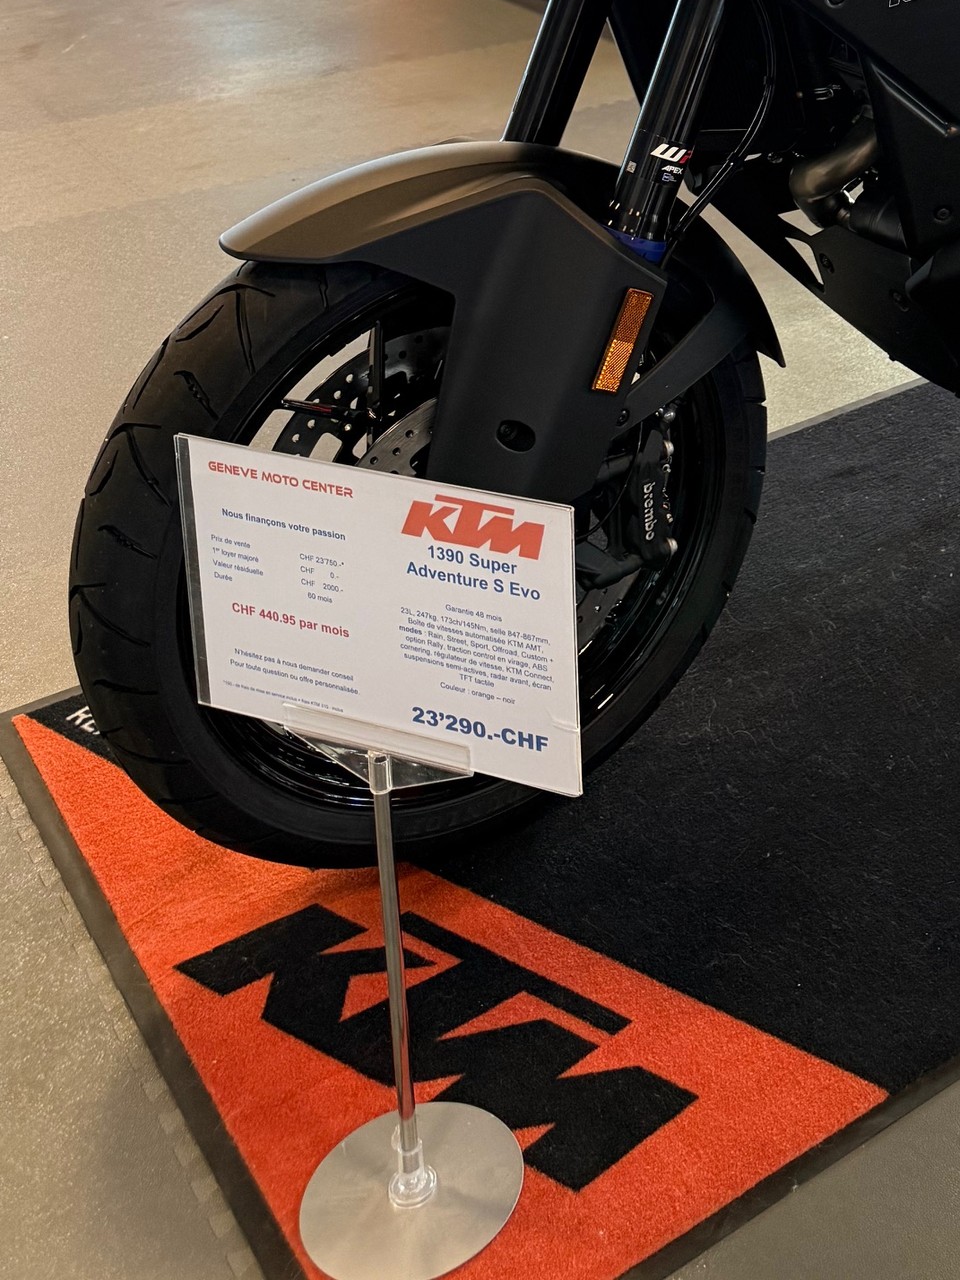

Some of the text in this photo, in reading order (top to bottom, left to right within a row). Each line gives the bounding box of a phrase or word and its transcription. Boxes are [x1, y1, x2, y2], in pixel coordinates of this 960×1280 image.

[661, 165, 684, 175] APEX
[208, 461, 353, 499] GENEVE MOTO CENTER
[222, 508, 346, 541] Nous finançons votre passion
[643, 481, 657, 540] brembo
[211, 534, 223, 543] Prix
[233, 541, 251, 549] vente
[401, 494, 545, 561] KTM
[212, 558, 264, 576] Valeur résiduelle
[428, 545, 517, 575] 1390 Super
[214, 571, 233, 582] Durée
[407, 561, 540, 600] Adventure S Evo
[317, 595, 333, 604] mois
[445, 604, 503, 622] Garantie 48 mois
[232, 602, 349, 638] CHF 440.95 par mois
[426, 622, 435, 630] de
[436, 624, 464, 636] vitesses
[465, 631, 506, 645] automatisée
[507, 638, 524, 649] KTM
[525, 643, 544, 654] AMT,
[230, 658, 245, 668] Pour
[245, 663, 261, 672] toute
[262, 667, 289, 678] question
[299, 675, 314, 684] offre
[459, 673, 495, 688] TFT tactile
[440, 682, 466, 693] Couleur
[471, 690, 495, 701] orange
[502, 697, 516, 705] noir
[412, 707, 549, 752] 23'290.-CHF
[174, 903, 700, 1193] KTM
